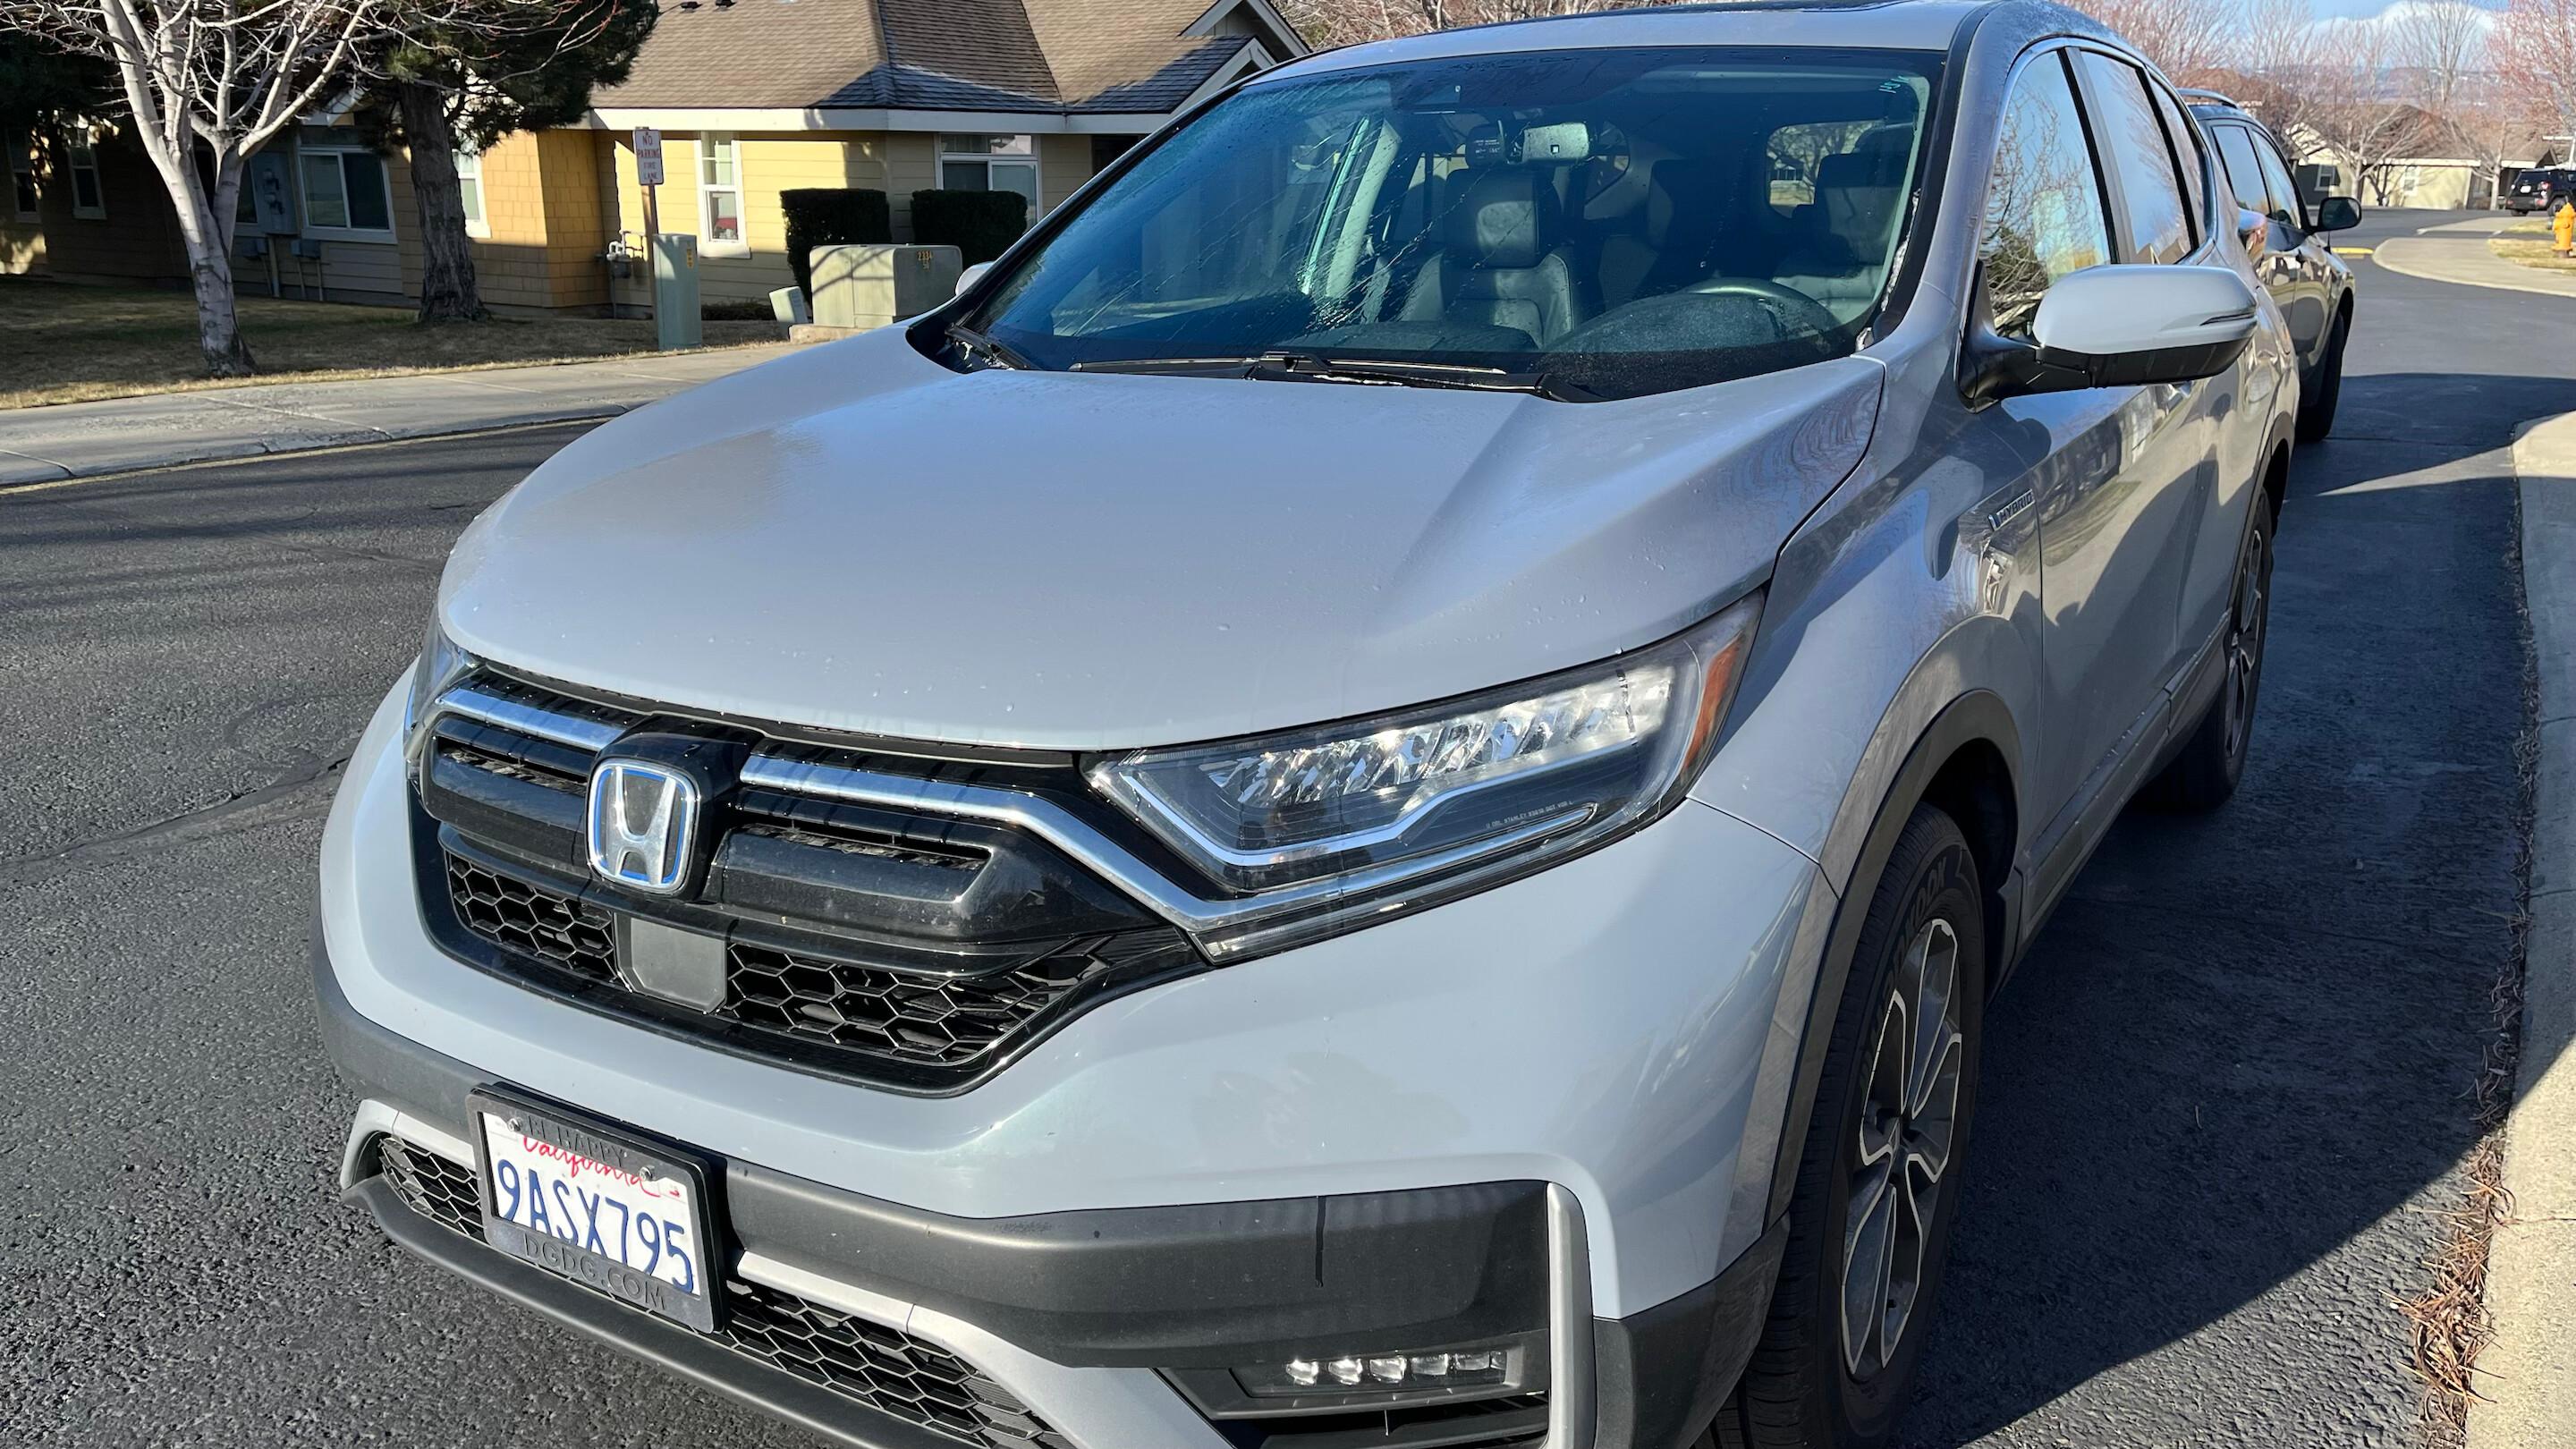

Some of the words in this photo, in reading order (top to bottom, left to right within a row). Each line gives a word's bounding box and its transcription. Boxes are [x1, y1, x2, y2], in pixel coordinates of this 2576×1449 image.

[637, 148, 660, 158] PARKING
[642, 135, 653, 146] NO
[1998, 492, 2033, 523] HYBRID
[497, 1159, 694, 1294] 9ASX795
[522, 1233, 666, 1310] DGDG.COM
